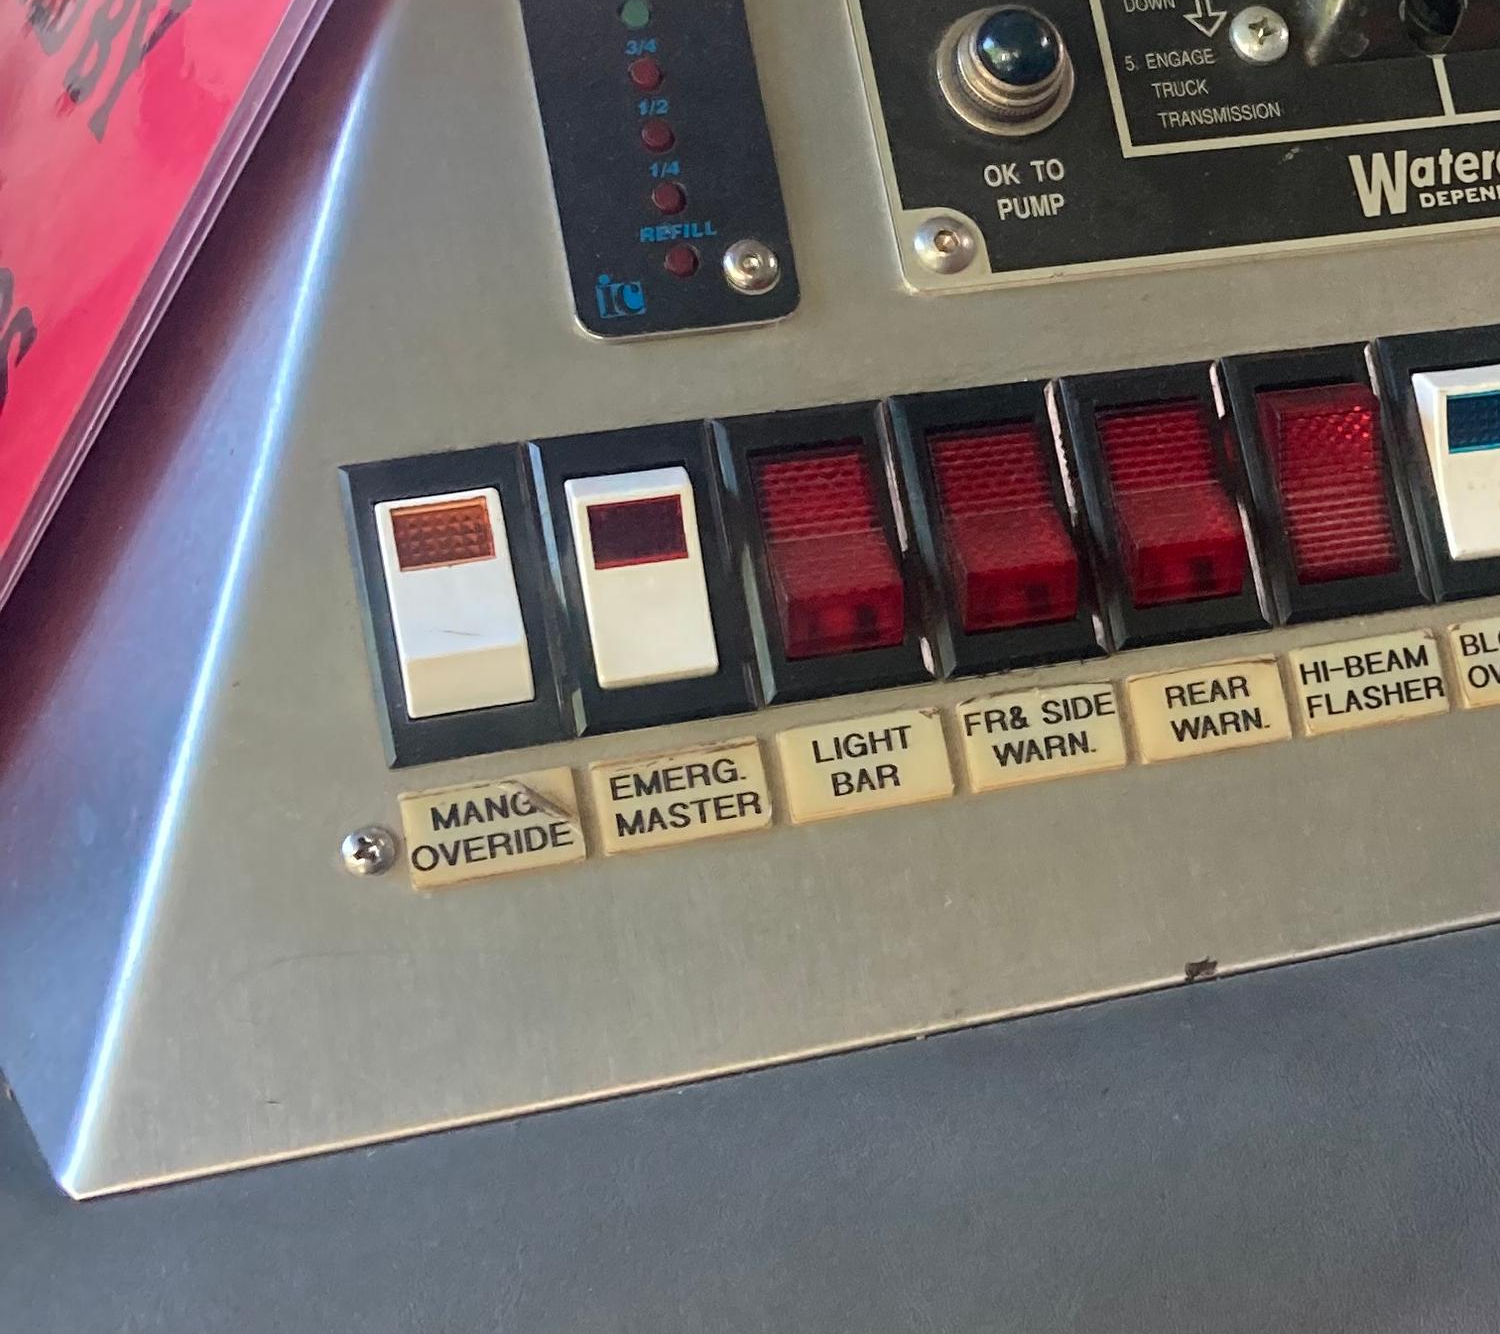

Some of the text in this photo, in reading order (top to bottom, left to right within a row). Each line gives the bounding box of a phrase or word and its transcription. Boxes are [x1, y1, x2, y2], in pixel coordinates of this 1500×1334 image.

[624, 37, 657, 55] 3/4
[1146, 49, 1216, 69] ENGAGE
[1152, 80, 1208, 98] TRUCK
[639, 99, 669, 115] 1/2
[1158, 104, 1280, 129] TRANSMISSION
[650, 161, 680, 177] 1/4
[983, 158, 1065, 187] OK TO
[997, 193, 1065, 221] PUMP
[640, 221, 717, 243] REFILL
[1300, 644, 1429, 685] HI-BEAM
[1165, 676, 1250, 710] REAR
[1306, 675, 1445, 719] FLASHER
[963, 691, 1116, 737] FR& SIDE
[1171, 707, 1270, 743] WARN.
[812, 725, 912, 763] LIGHT
[992, 730, 1097, 767] WARN.
[610, 758, 746, 801] EMERG.
[831, 764, 901, 798] BAR
[616, 791, 762, 838] MASTER
[411, 821, 575, 873] OVERIDE
